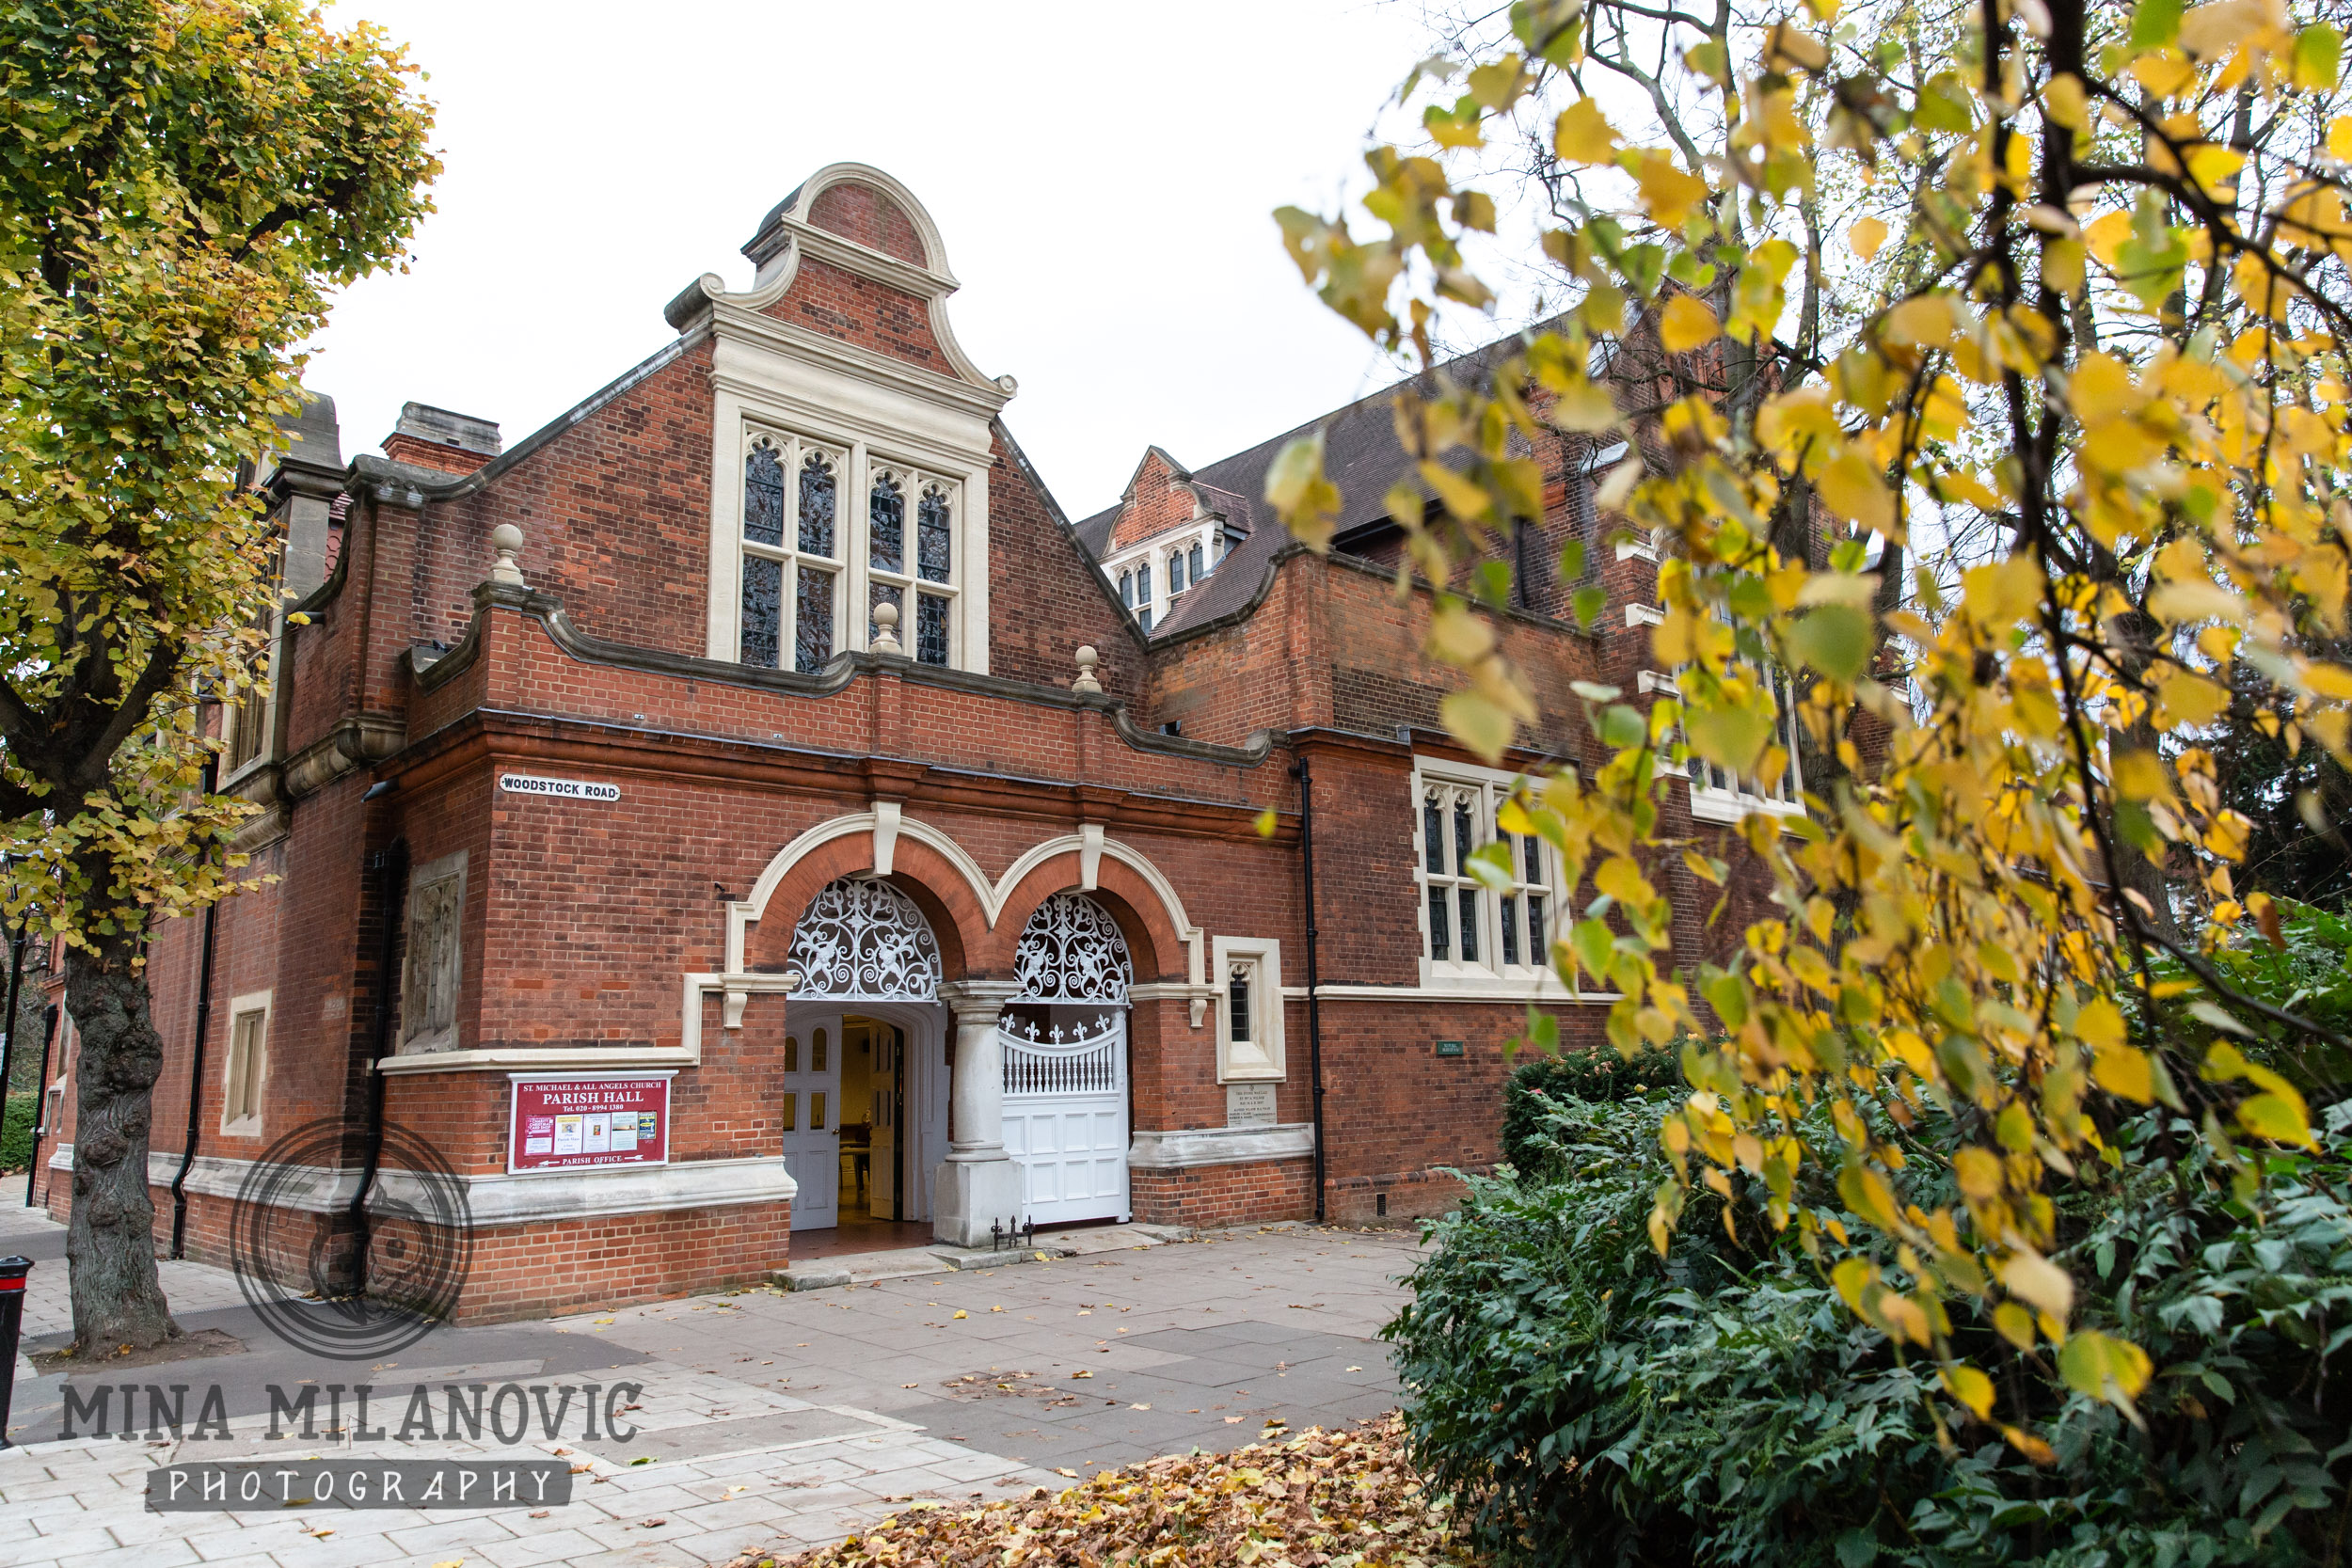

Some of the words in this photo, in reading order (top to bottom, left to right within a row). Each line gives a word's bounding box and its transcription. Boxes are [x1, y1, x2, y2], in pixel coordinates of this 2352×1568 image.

[504, 777, 580, 795] WOODSTOCK
[585, 785, 616, 799] ROAD
[598, 1082, 628, 1090] ANGELS
[630, 1081, 661, 1089] CHURCH
[542, 1092, 599, 1105] PARISH
[603, 1091, 644, 1103] HALL
[594, 1155, 622, 1164] OFFICE
